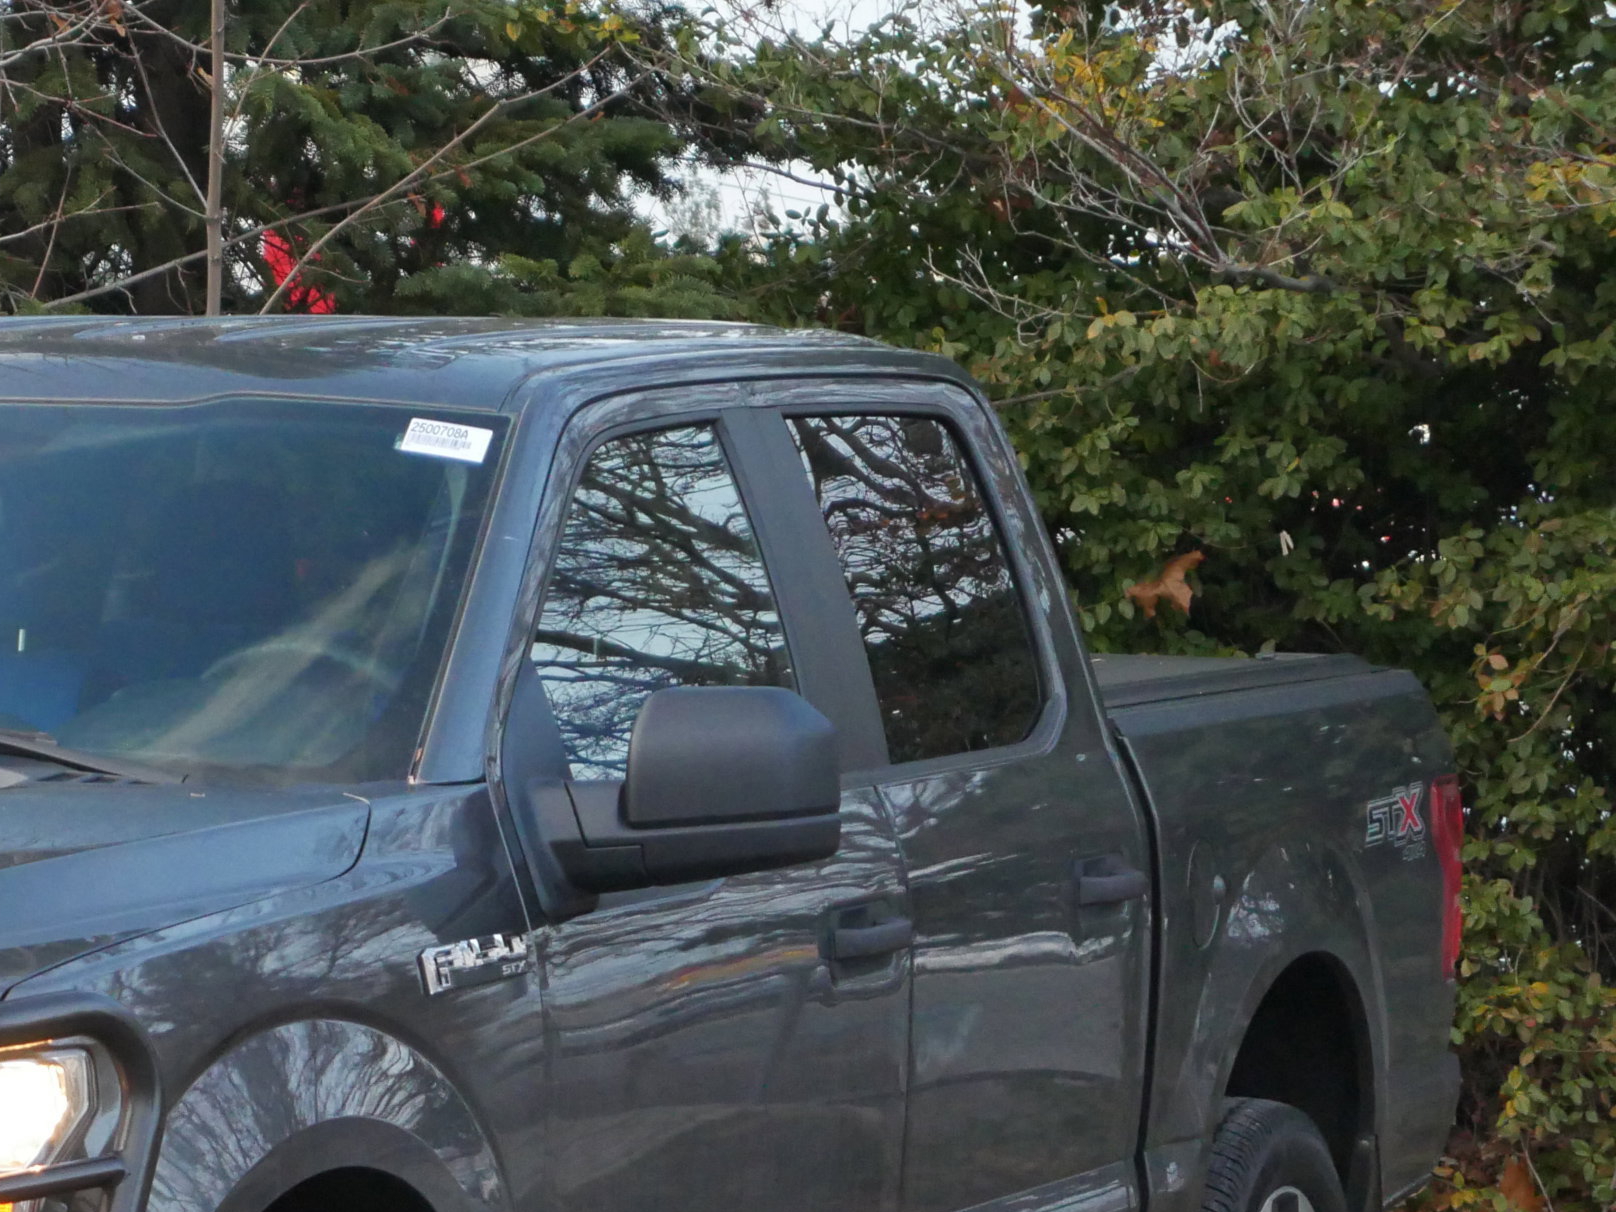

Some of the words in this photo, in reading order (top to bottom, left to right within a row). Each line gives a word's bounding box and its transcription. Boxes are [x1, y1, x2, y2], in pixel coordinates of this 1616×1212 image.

[410, 421, 469, 440] 2500708A
[1365, 781, 1425, 847] STX
[501, 960, 527, 976] STX
